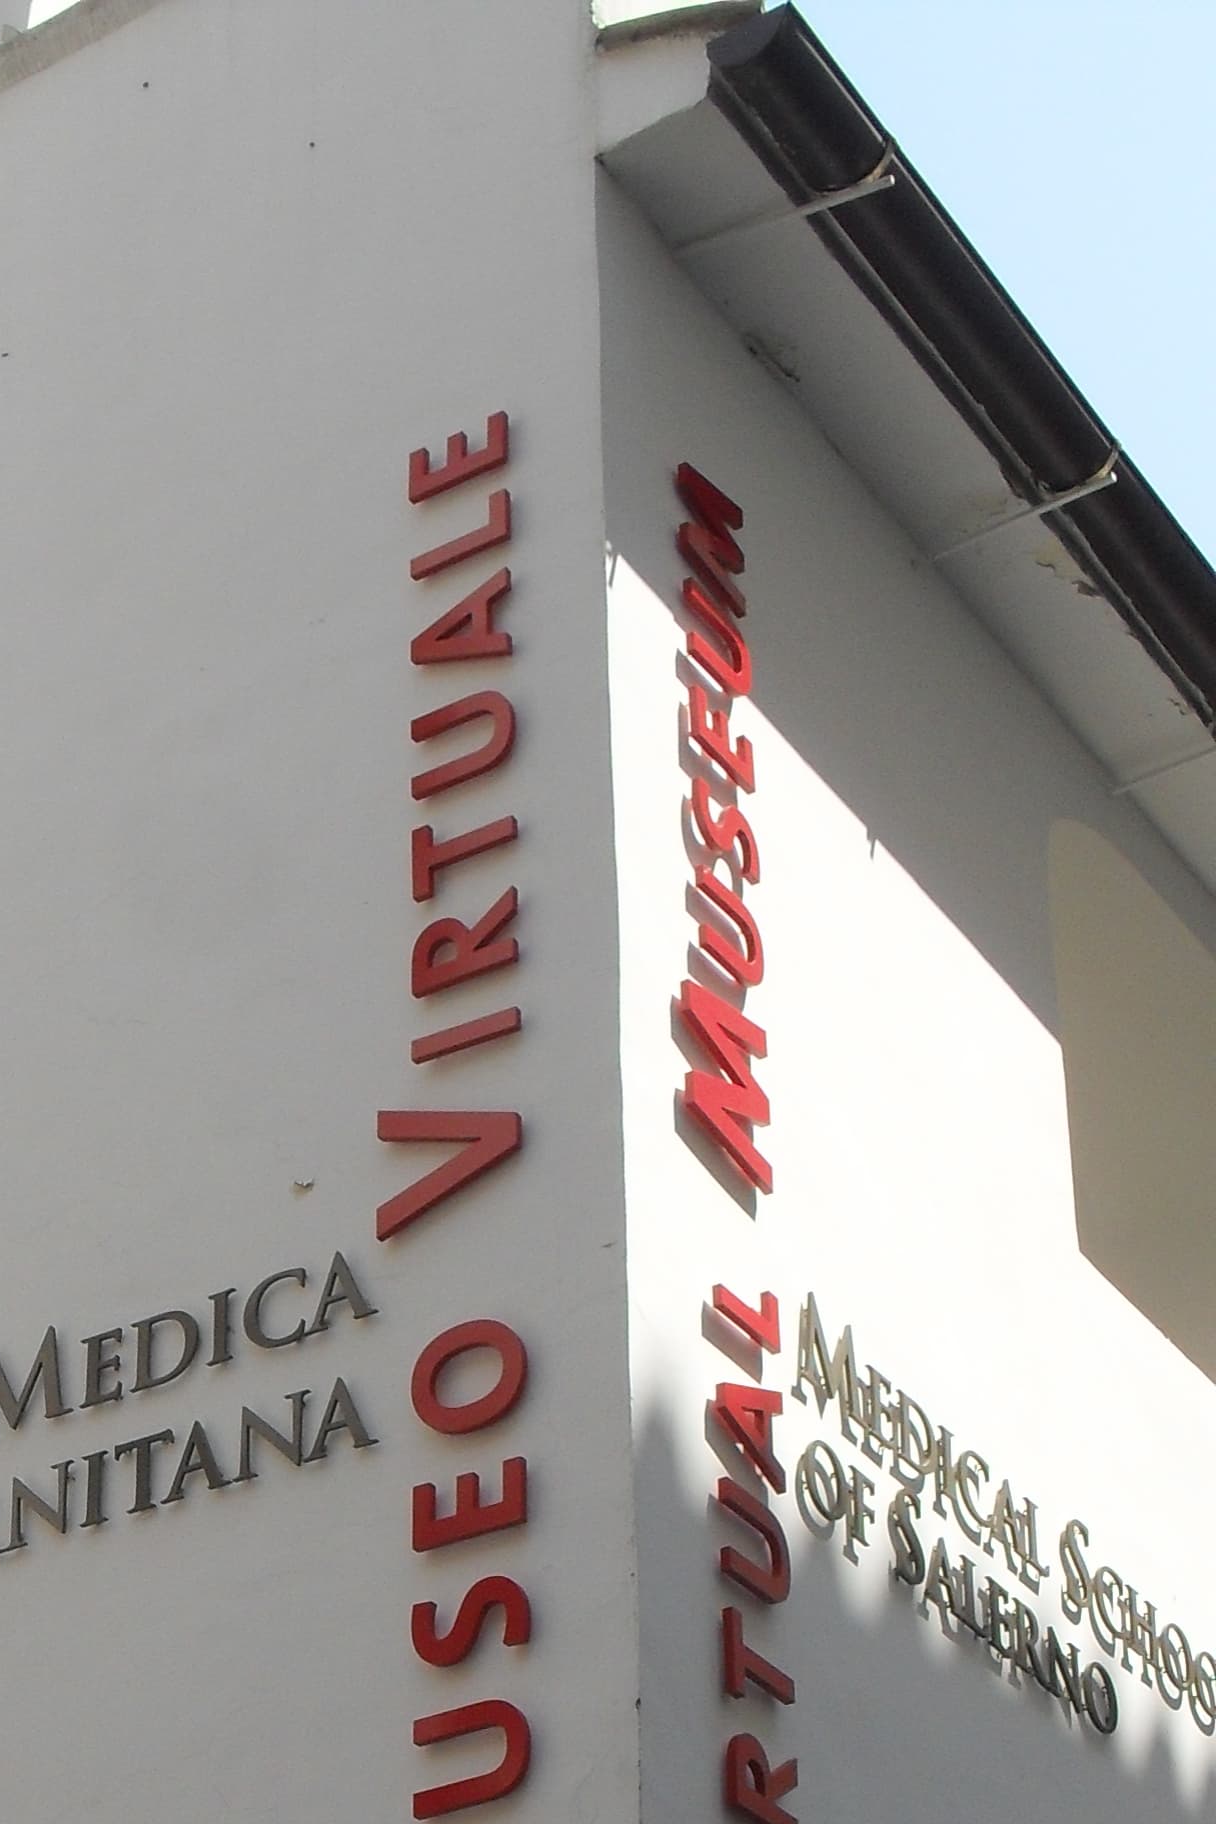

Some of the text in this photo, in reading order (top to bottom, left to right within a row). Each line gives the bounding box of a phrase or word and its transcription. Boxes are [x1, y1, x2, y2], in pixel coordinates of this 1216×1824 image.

[377, 409, 523, 1241] VIRTUALE
[676, 461, 774, 1196] MUSEUM
[792, 1291, 1050, 1586] MEDICAL
[796, 1439, 1120, 1735] OF SALERNO
